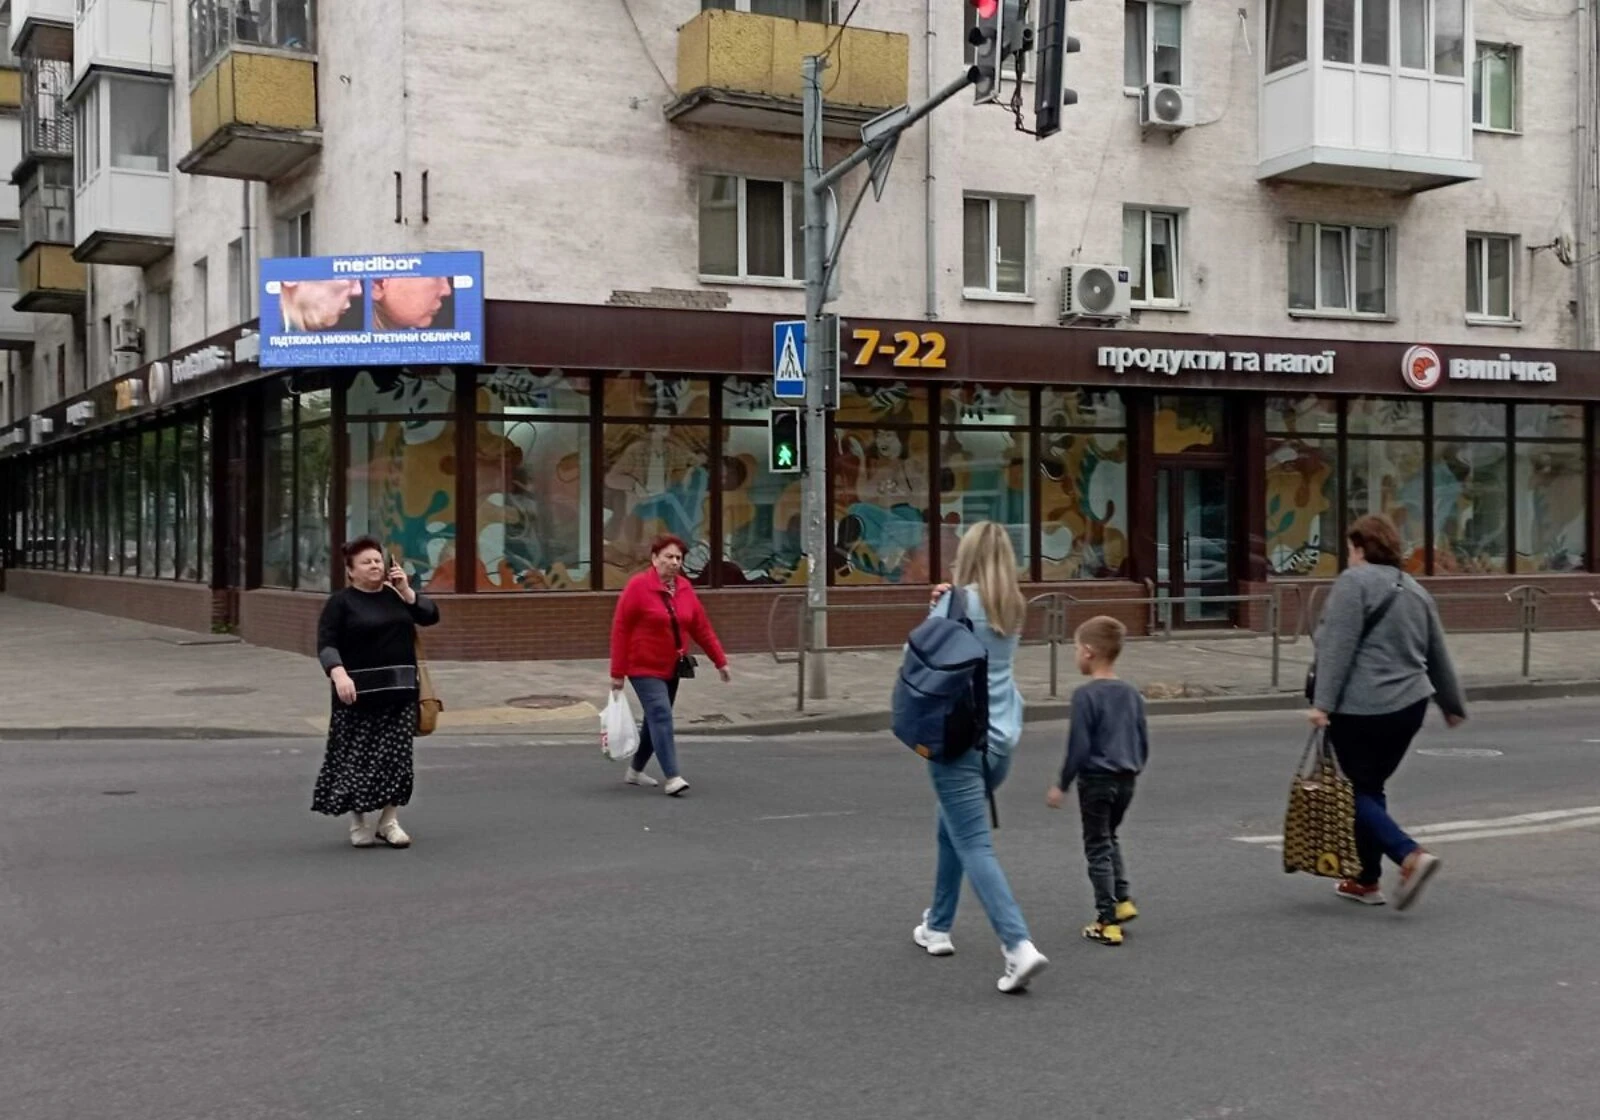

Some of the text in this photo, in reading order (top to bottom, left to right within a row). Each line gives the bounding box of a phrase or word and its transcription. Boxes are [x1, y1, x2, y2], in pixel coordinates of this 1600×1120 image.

[333, 256, 422, 272] medibor
[270, 331, 471, 347] ПІДТЯЖКА НИЖНЬОЇ ТРЕТИНИ ОБЛИЧЧЯ
[852, 328, 947, 368] 7-22
[1098, 346, 1337, 376] продукти та напої
[1449, 353, 1557, 382] випічка
